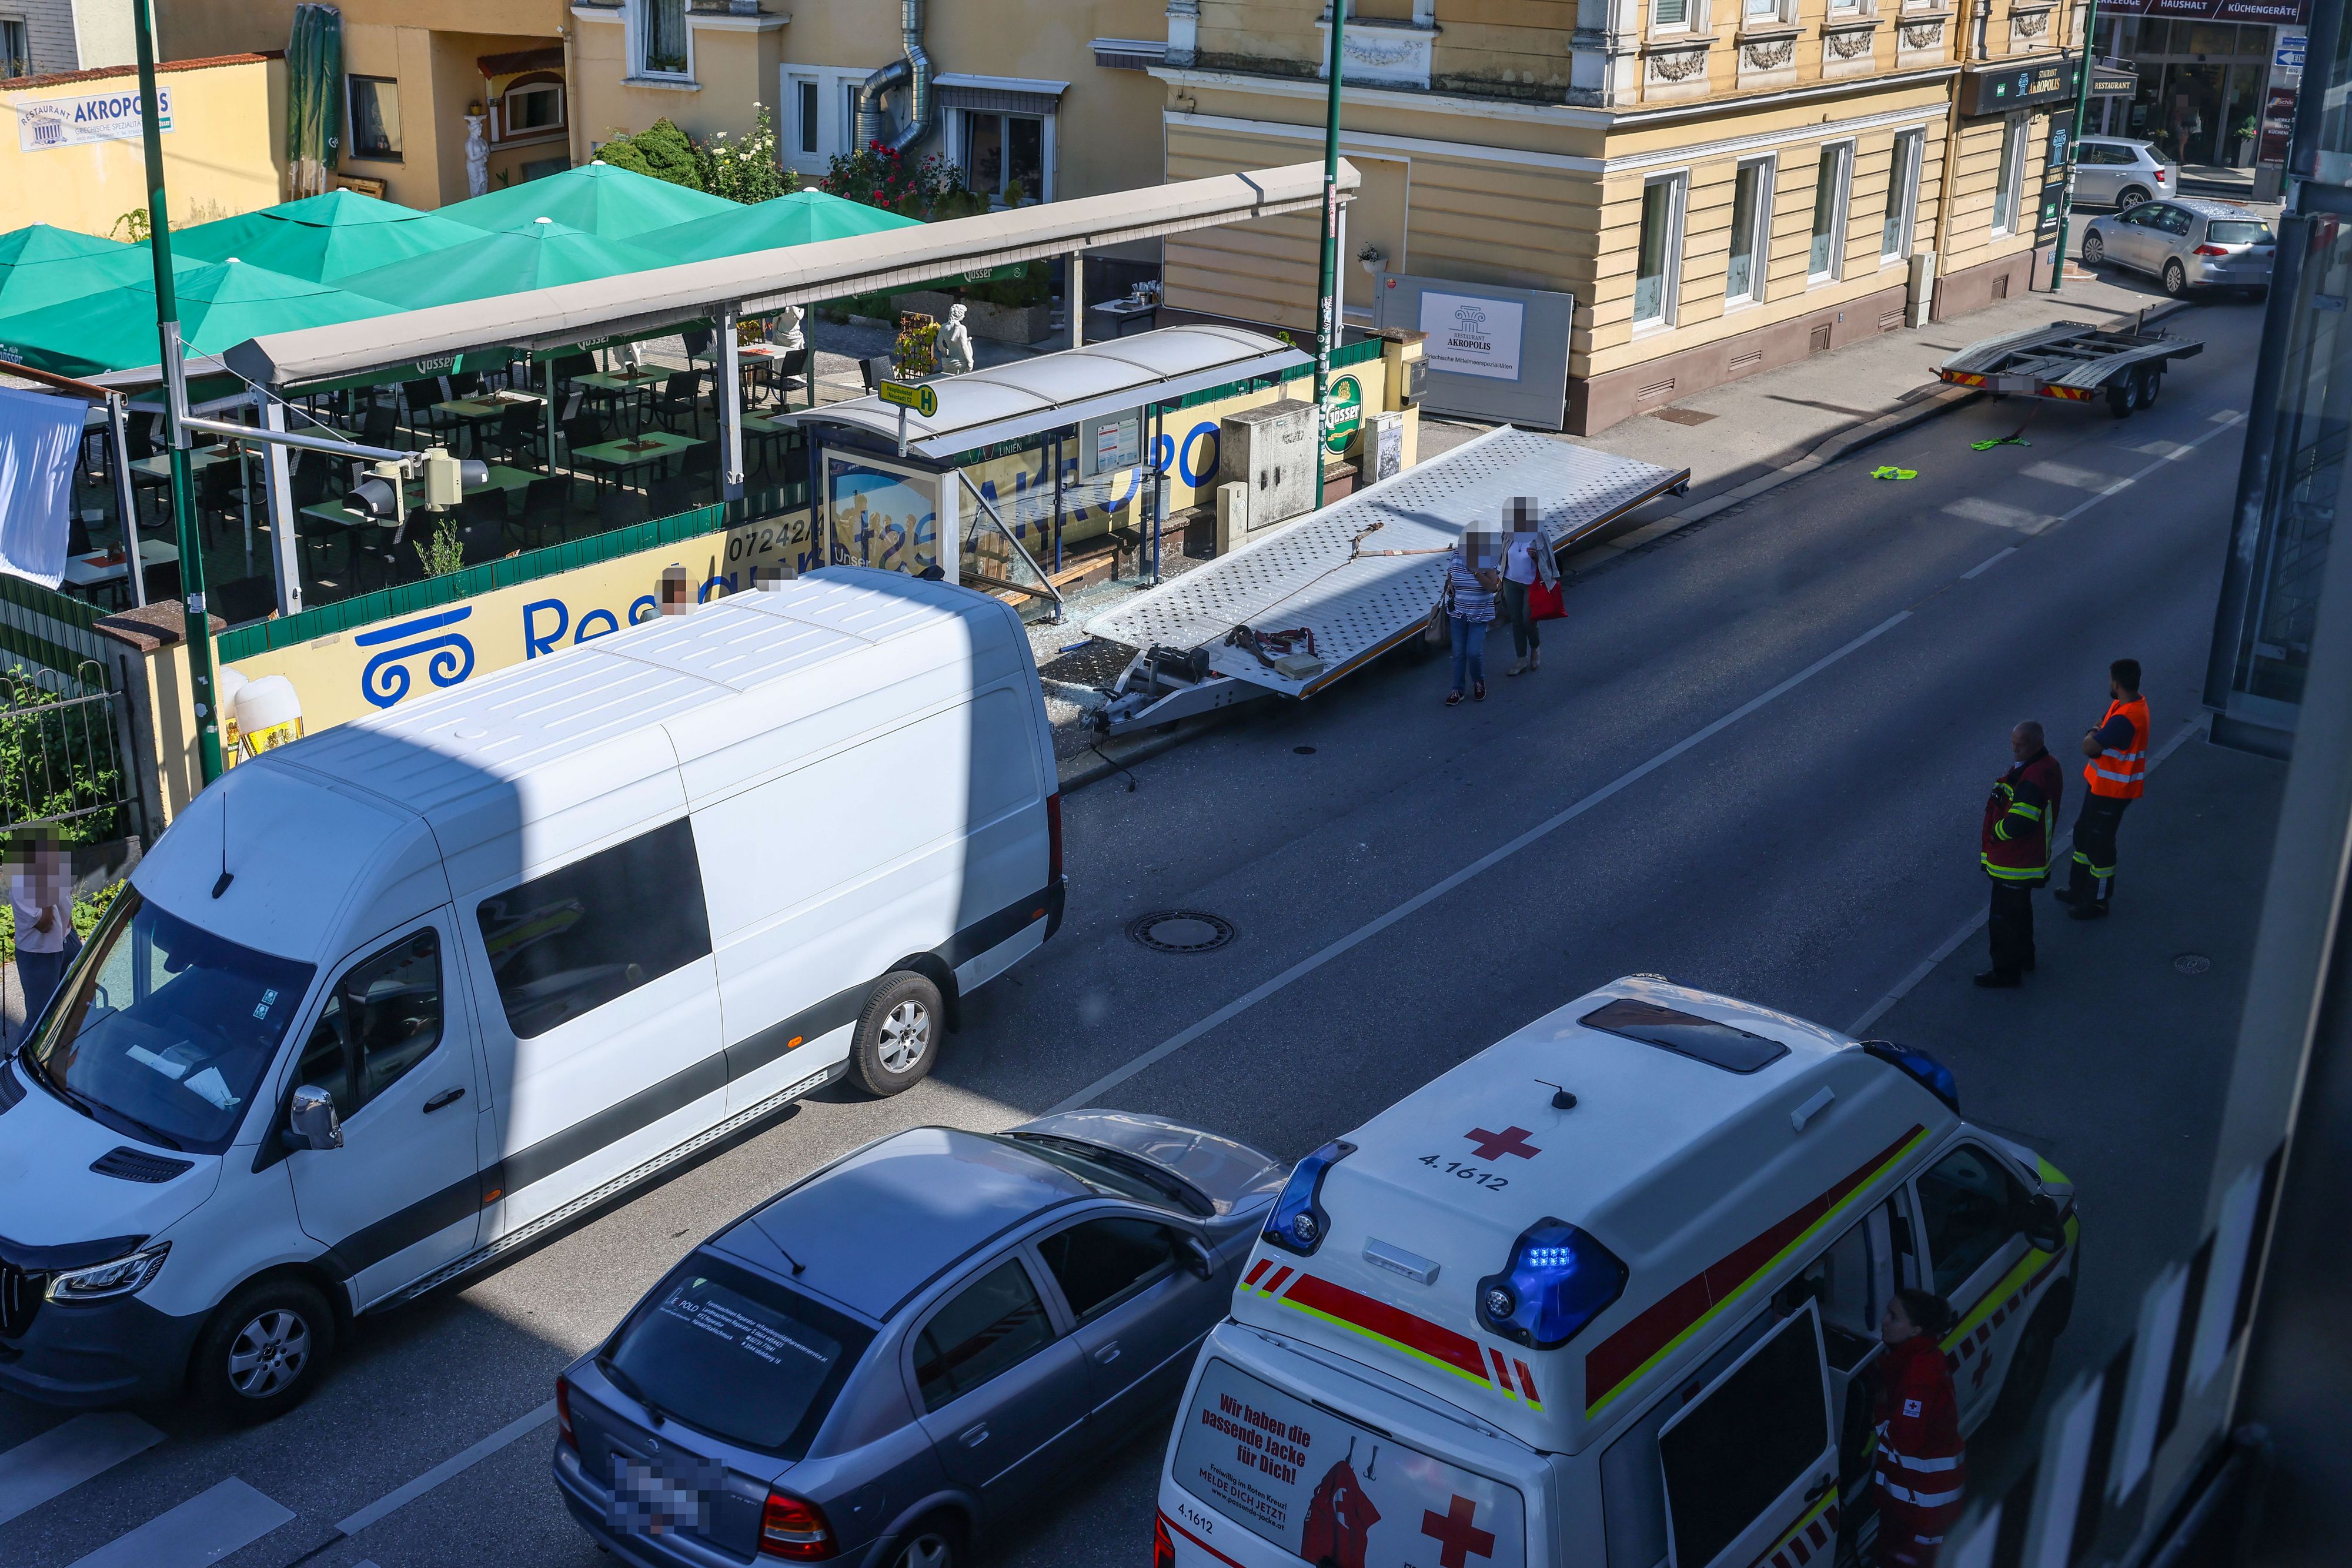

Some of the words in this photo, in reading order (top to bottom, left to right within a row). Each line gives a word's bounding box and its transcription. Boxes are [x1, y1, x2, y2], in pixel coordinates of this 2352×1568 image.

[2161, 1, 2207, 9] HAUSHALT
[2228, 4, 2297, 16] KÜCHENGERÄTE
[22, 105, 71, 126] RESTAURANT
[75, 123, 111, 135] GRIECHISCHE
[1448, 338, 1491, 350] AKROPOLIS
[1454, 333, 1485, 341] RESTAURANT
[1425, 353, 1454, 362] Griechische
[1455, 357, 1512, 369] Mittelmeerspezialitäten
[887, 392, 906, 402] (Neustadt)
[887, 385, 913, 396] Hauptbahnhof
[921, 390, 932, 412] H
[1325, 403, 1360, 430] Gösser
[1000, 442, 1022, 456] LINIEN
[834, 547, 871, 568] Unser
[1418, 1155, 1509, 1192] 4.1612
[1220, 1393, 1242, 1418] Wir
[1244, 1405, 1286, 1438] haben
[1288, 1425, 1311, 1447] die
[1202, 1409, 1263, 1449] passende
[1265, 1436, 1305, 1467] Jacke
[1237, 1445, 1257, 1467] für
[1259, 1455, 1297, 1485] Dich!
[1199, 1467, 1228, 1493] MELDE
[1231, 1486, 1254, 1506] DICH
[1255, 1500, 1286, 1523] JETZT!
[1210, 1463, 1237, 1486] Freiwillig
[1238, 1479, 1246, 1489] im
[1247, 1484, 1265, 1499] Roten
[1267, 1494, 1287, 1510] Kreuz!
[1178, 1503, 1213, 1534] 4.1612
[1211, 1487, 1285, 1531] www.passende-jacke.at
